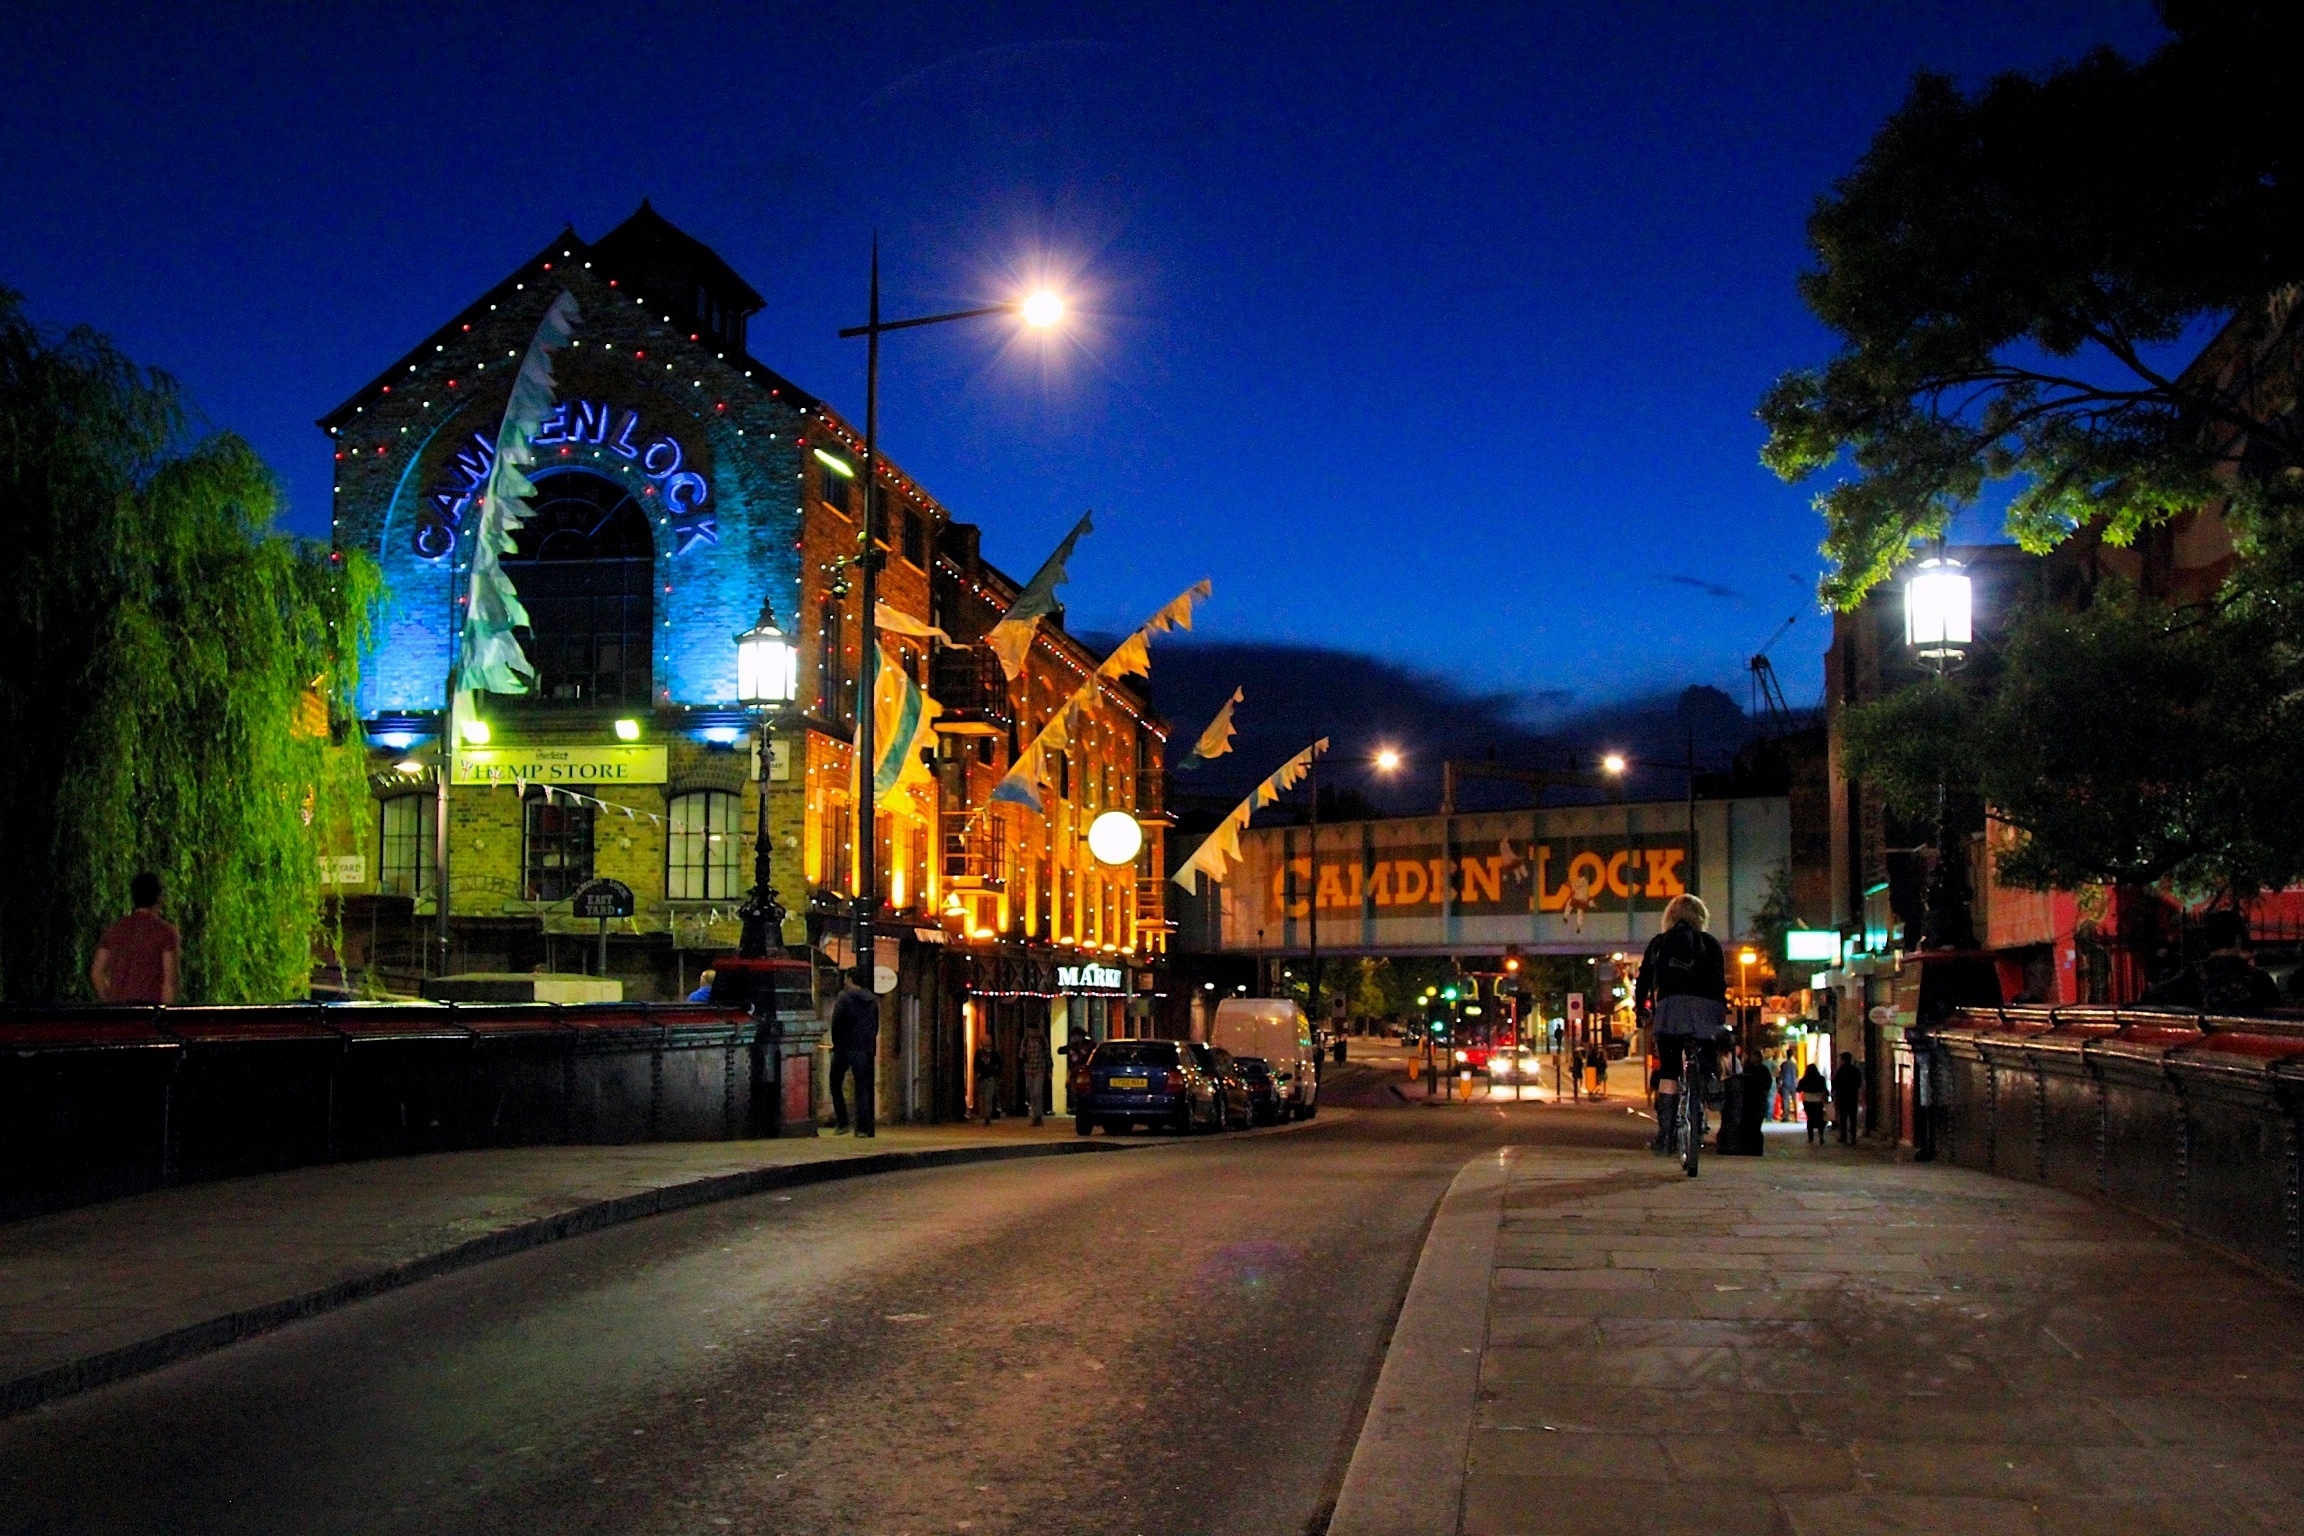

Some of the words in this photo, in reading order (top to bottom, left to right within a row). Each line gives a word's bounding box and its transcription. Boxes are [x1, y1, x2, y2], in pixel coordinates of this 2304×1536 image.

[608, 408, 719, 556] LOCK
[550, 764, 628, 780] STORE
[608, 879, 630, 899] LOCK
[1272, 855, 1502, 918] CAMDEN
[1528, 844, 1686, 913] LOCK
[586, 893, 613, 905] EAST
[585, 904, 615, 916] YARD
